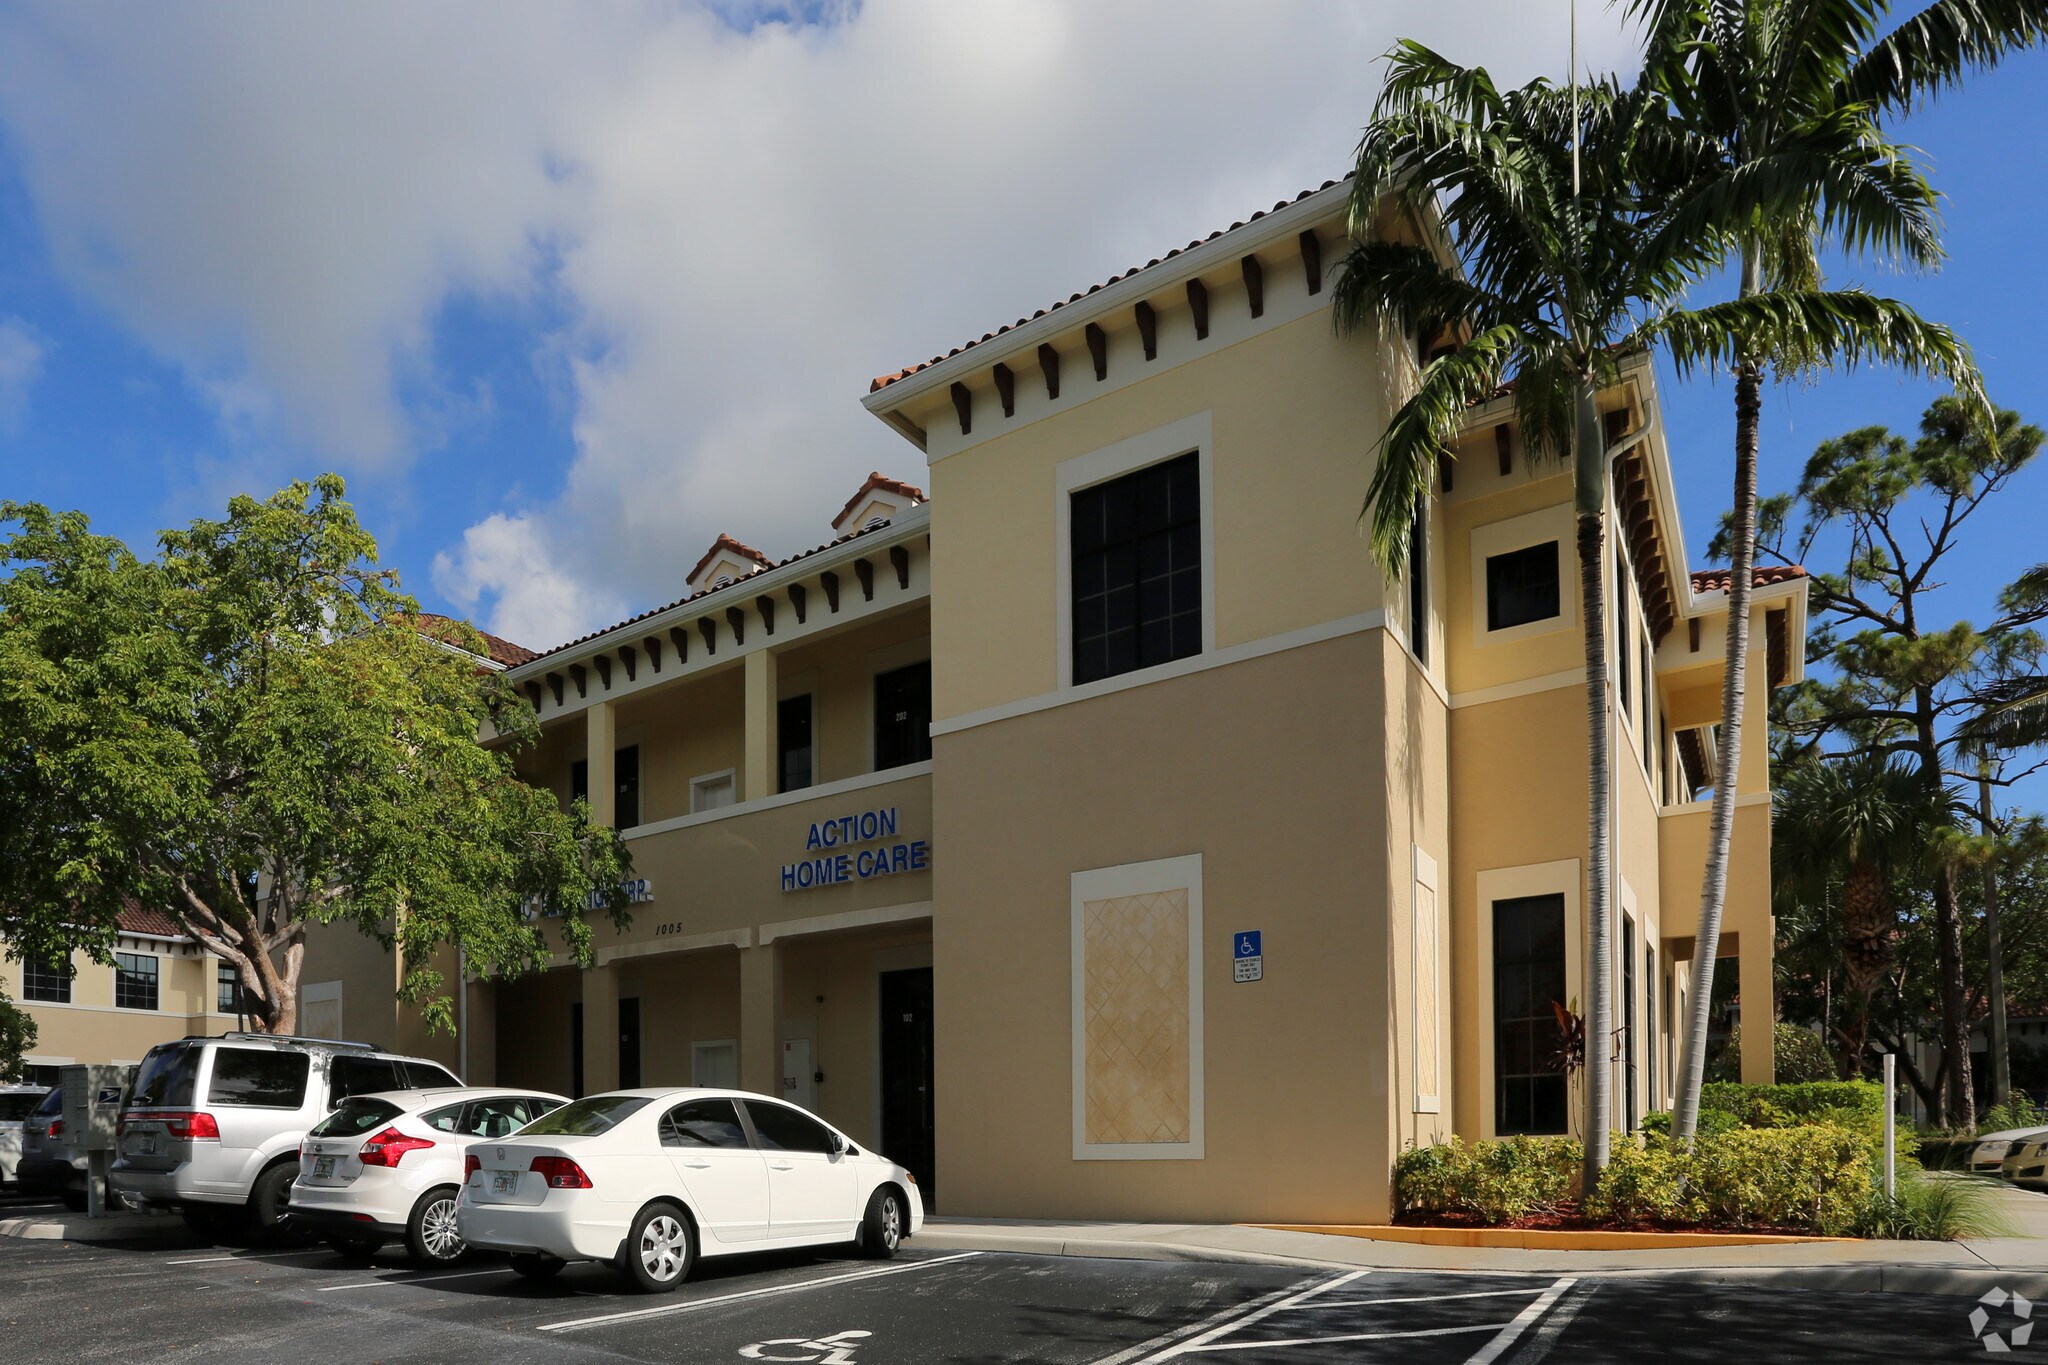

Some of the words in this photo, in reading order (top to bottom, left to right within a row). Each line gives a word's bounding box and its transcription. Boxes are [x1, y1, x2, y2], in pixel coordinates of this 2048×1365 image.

[896, 711, 907, 722] 202
[806, 807, 897, 850] ACTION
[781, 855, 850, 891] HOME
[857, 840, 926, 879] CARE
[656, 922, 682, 936] 1005
[903, 1013, 913, 1022] 102
